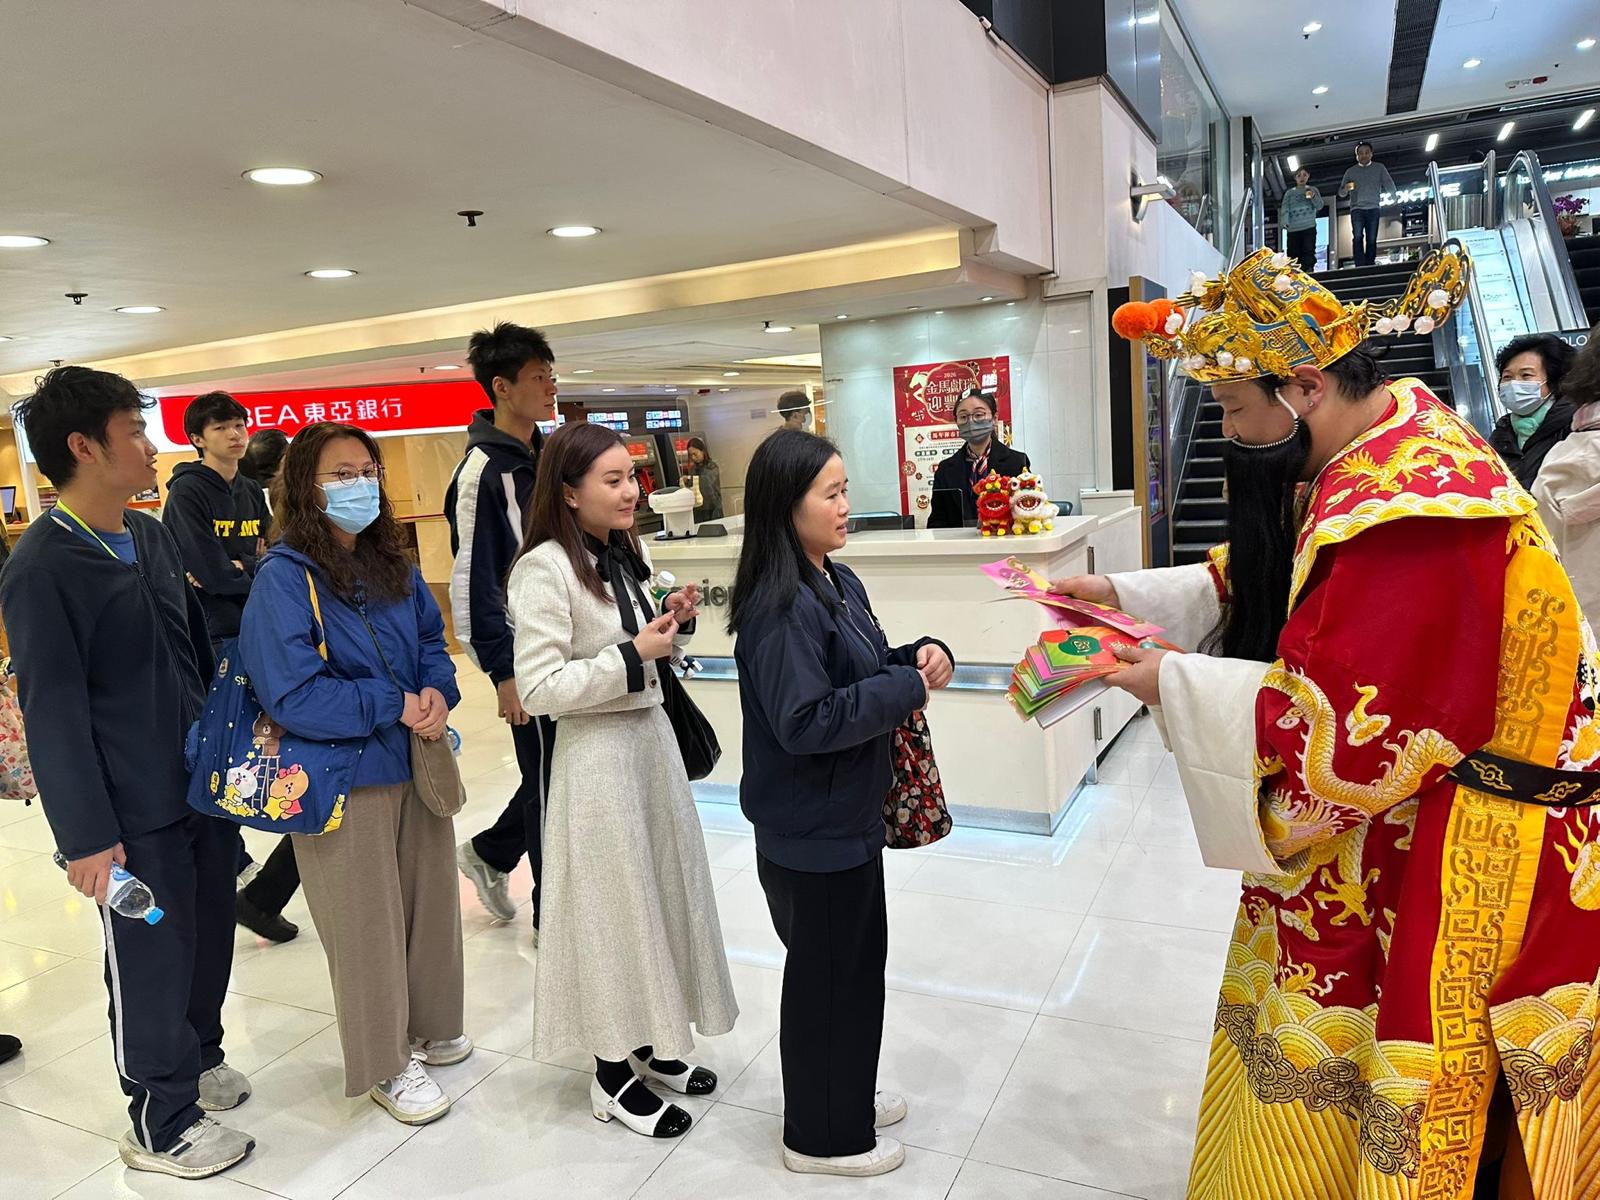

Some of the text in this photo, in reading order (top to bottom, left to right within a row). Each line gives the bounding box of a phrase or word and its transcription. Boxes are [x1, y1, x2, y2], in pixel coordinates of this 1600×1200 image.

[246, 397, 402, 428] BEA 東亞銀行
